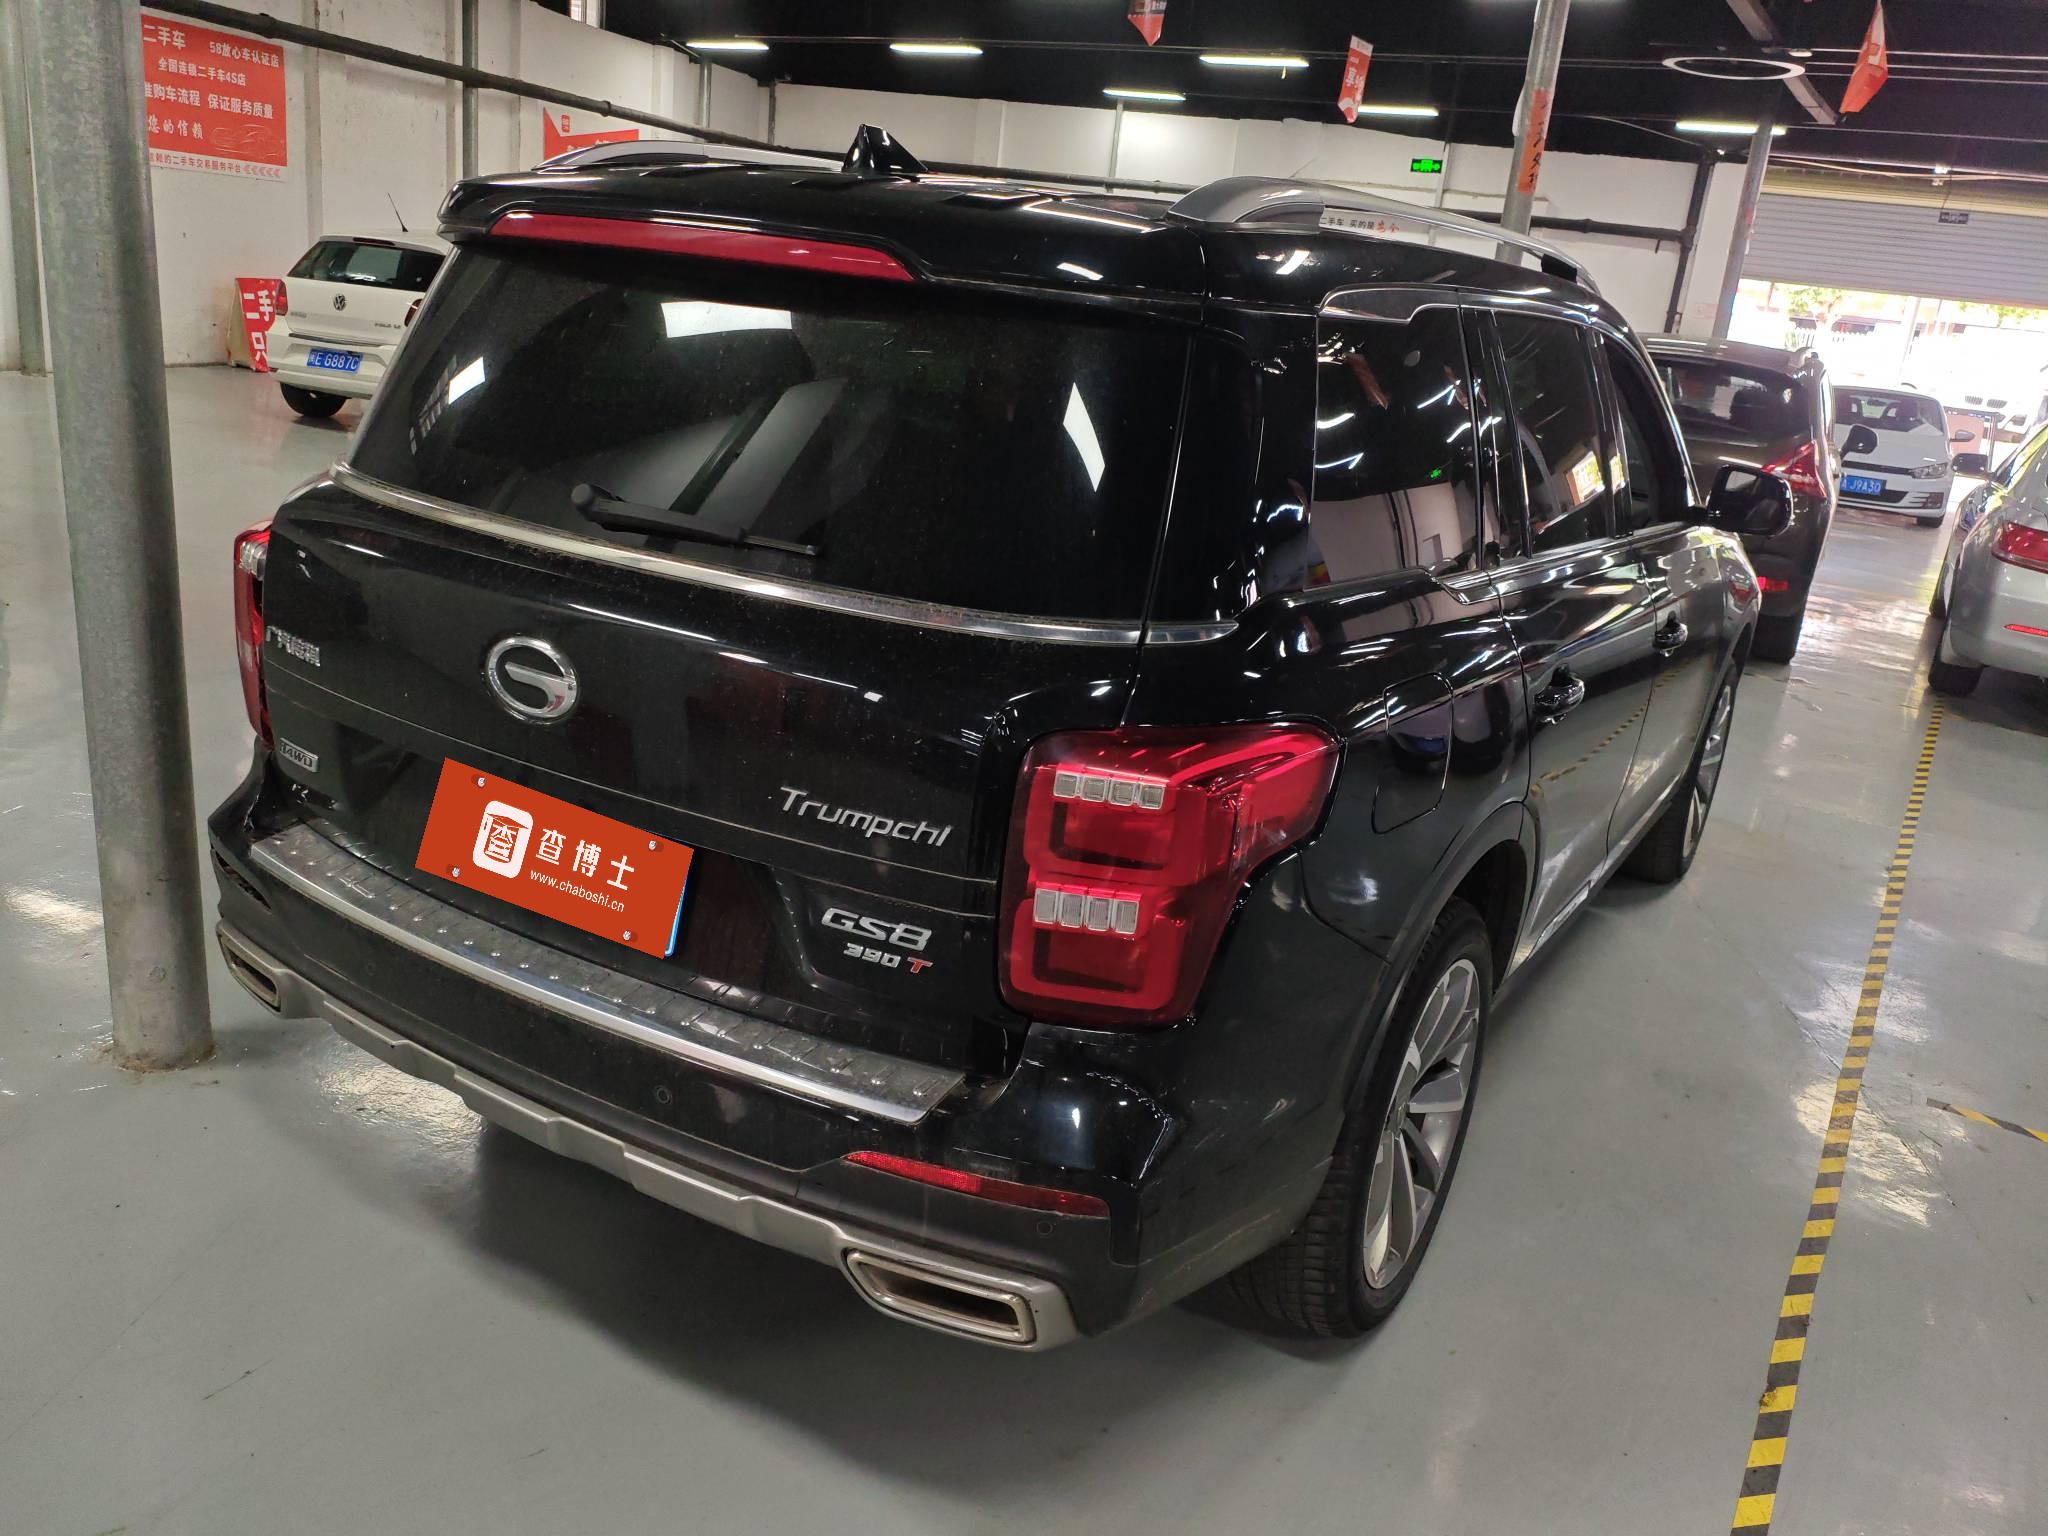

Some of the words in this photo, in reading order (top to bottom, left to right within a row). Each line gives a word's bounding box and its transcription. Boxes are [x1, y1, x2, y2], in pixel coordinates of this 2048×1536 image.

[143, 24, 186, 51] 二手车
[209, 41, 279, 68] 58放心车认证店
[158, 56, 247, 87] 全国连锁二手车4S店
[207, 93, 273, 119] 保证服务质量
[243, 289, 276, 322] 二手
[820, 907, 933, 951] GS8
